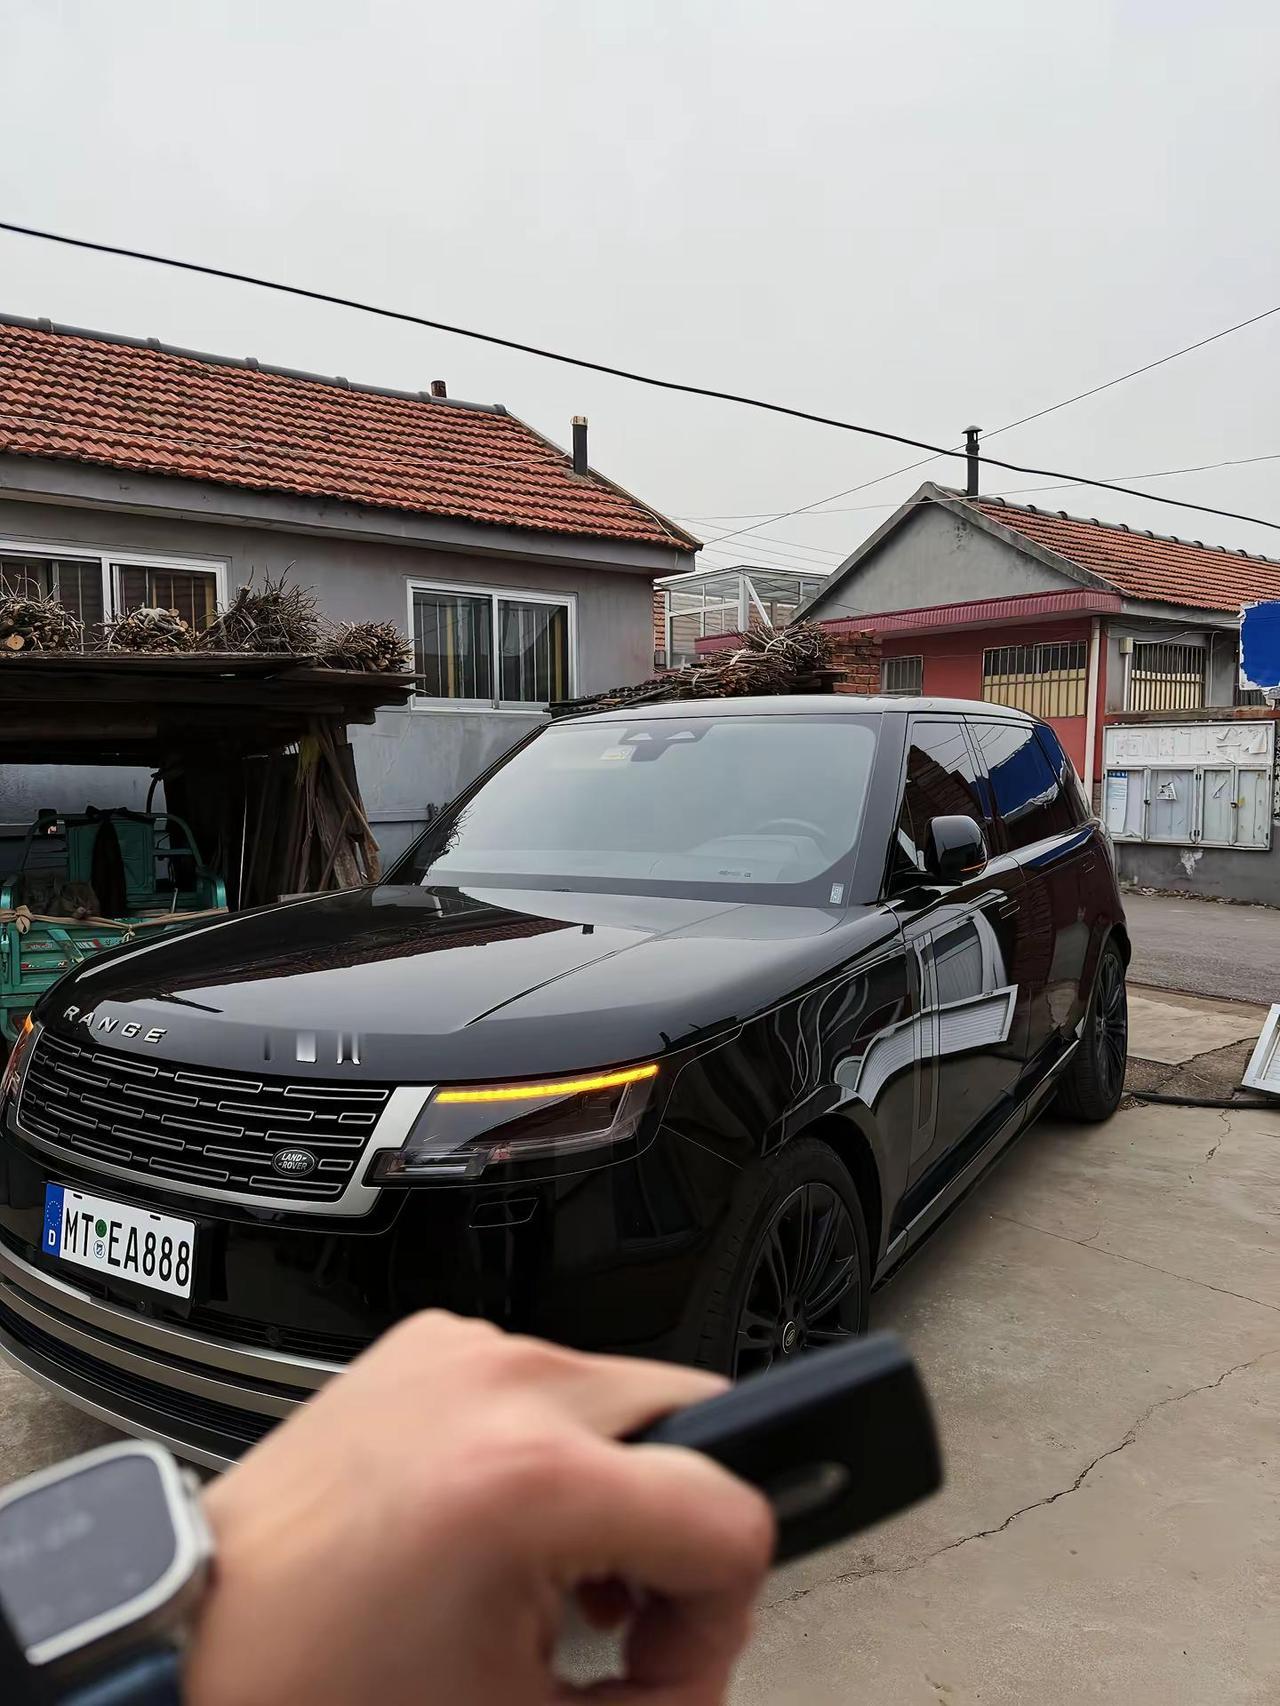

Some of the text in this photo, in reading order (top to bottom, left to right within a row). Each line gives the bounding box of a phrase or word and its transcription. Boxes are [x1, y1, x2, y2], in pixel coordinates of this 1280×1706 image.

[63, 1005, 167, 1044] RANGE
[281, 1160, 308, 1170] ROVER
[48, 1229, 56, 1246] D
[107, 1220, 190, 1287] EA888
